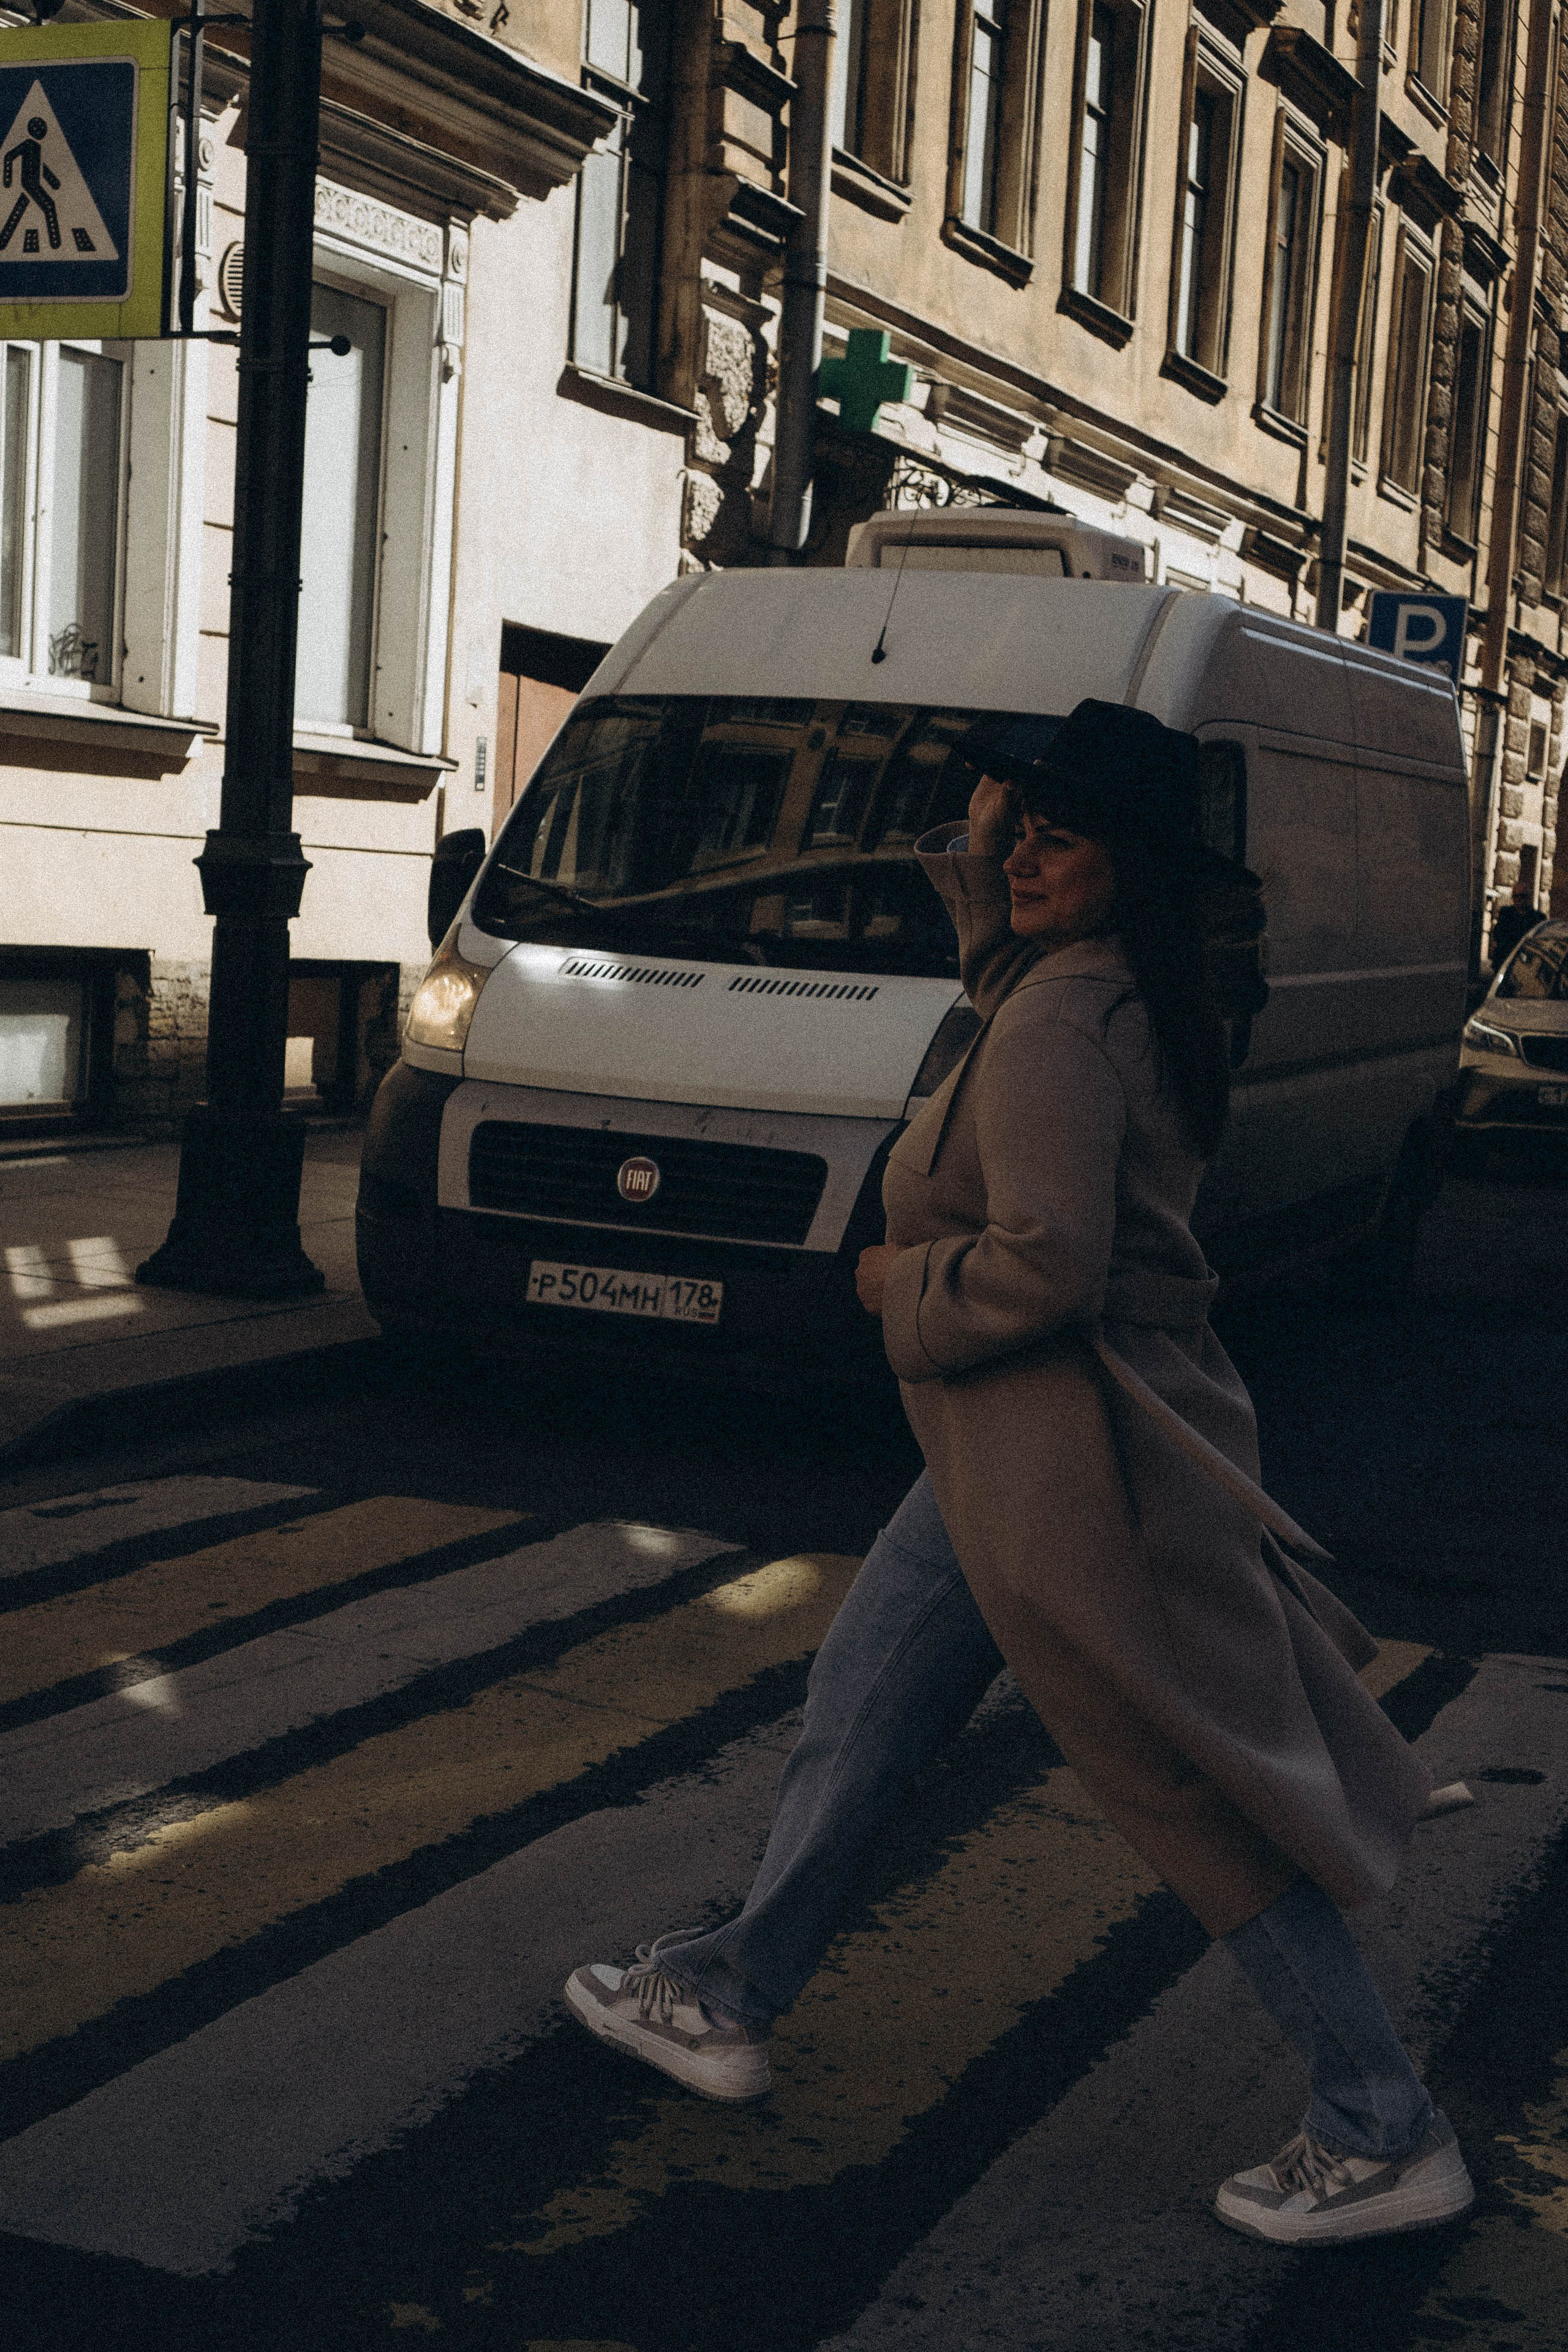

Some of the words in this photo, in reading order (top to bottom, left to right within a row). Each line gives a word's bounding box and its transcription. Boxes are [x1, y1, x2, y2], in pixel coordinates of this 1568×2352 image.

[1394, 603, 1447, 655] P
[625, 1169, 653, 1191] FIAT
[674, 1306, 698, 1317] RUS
